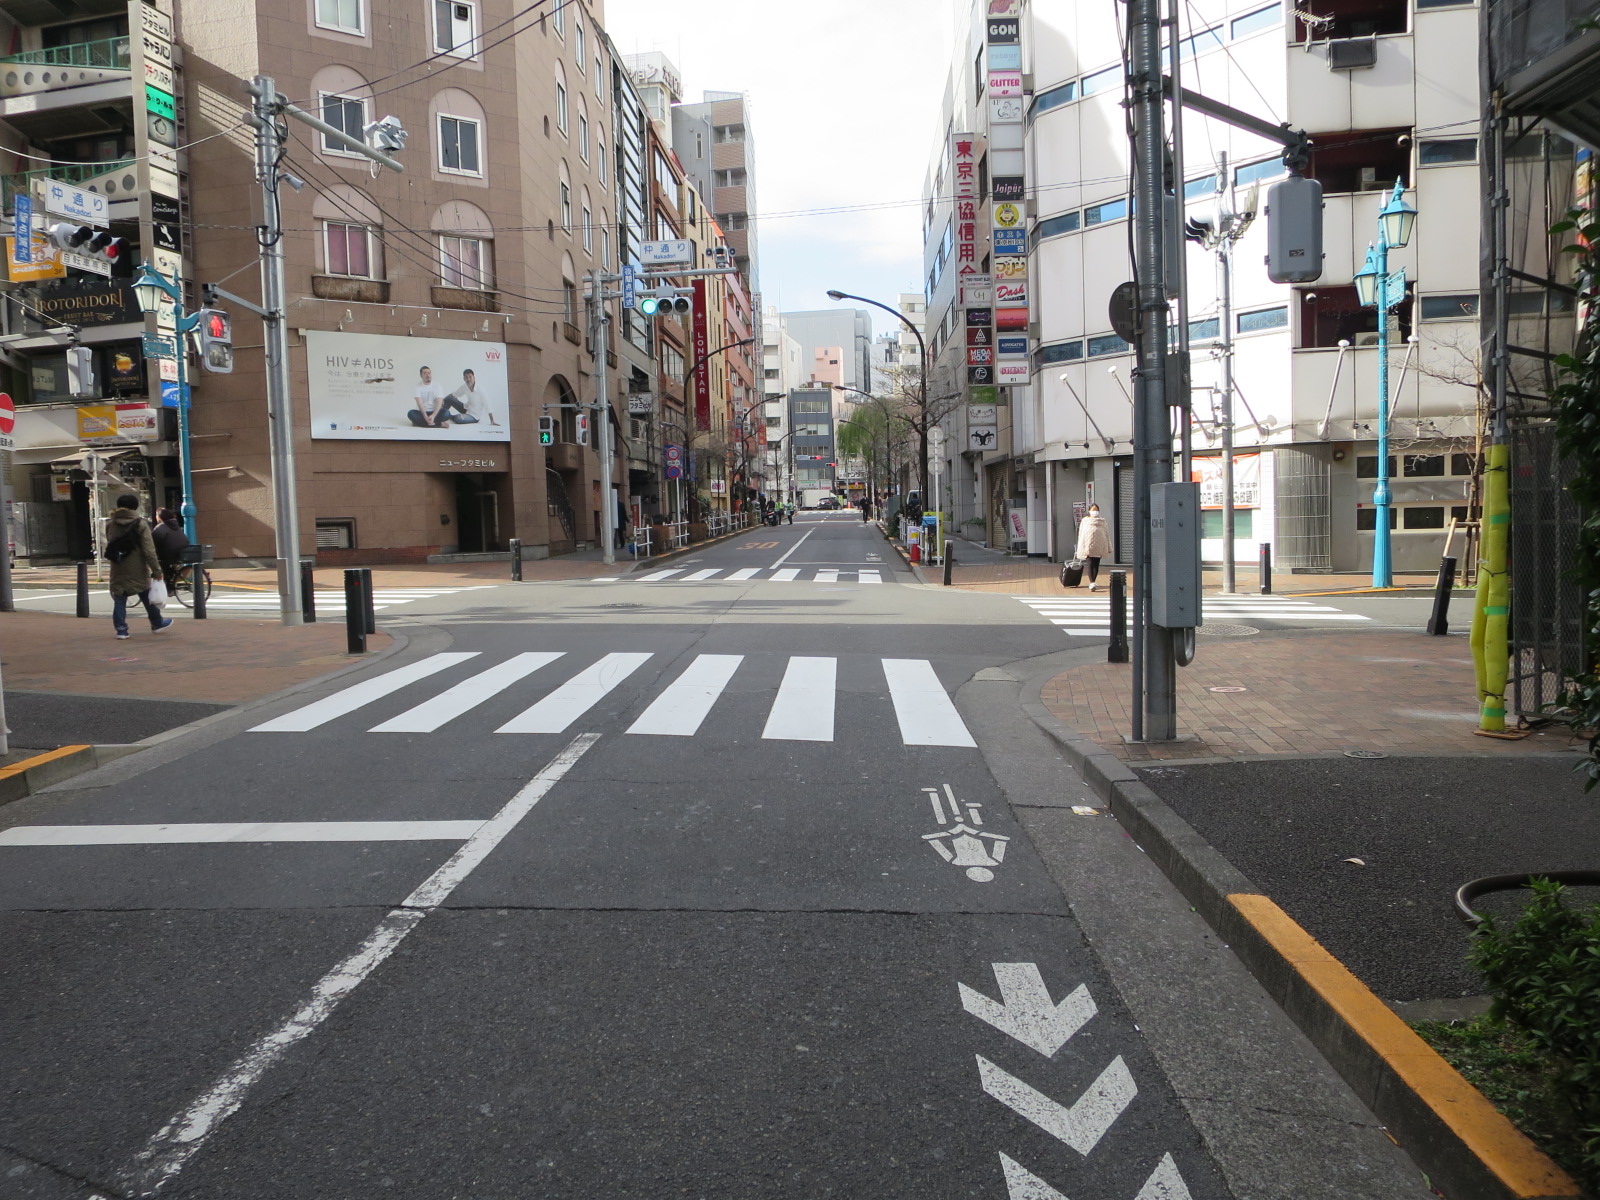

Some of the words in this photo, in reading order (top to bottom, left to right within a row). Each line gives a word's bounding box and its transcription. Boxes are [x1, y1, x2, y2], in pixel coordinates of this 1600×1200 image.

[142, 16, 169, 37] フタミビル
[990, 24, 1017, 35] GON
[143, 36, 170, 60] キャラバン
[990, 79, 1020, 87] GLITTER
[51, 185, 103, 211] 仲通り
[64, 204, 92, 218] Nakadori
[644, 243, 686, 254] 仲通り
[996, 283, 1025, 299] Dash
[439, 459, 496, 467] ニューフタミビル
